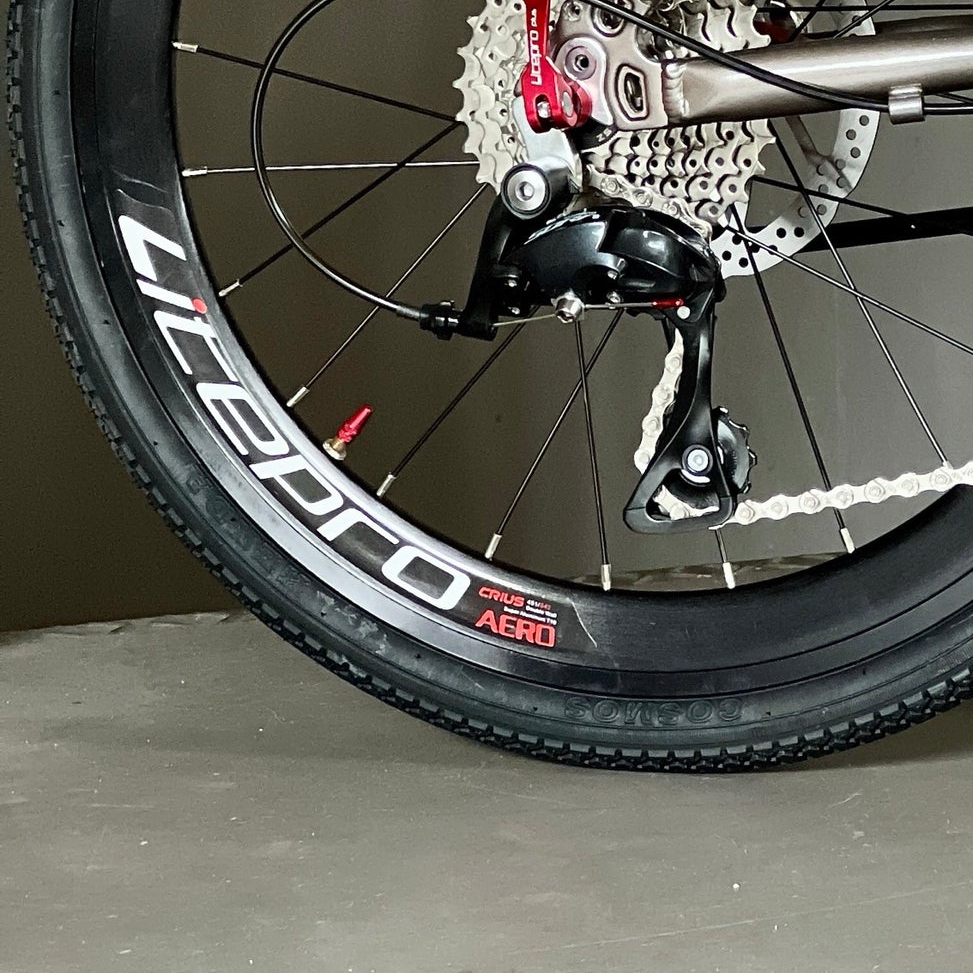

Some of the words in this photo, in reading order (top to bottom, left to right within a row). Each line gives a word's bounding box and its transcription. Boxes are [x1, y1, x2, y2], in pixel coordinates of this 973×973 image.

[118, 214, 471, 611] Litepro
[478, 586, 525, 608] CRIUS
[474, 609, 556, 648] AERO
[563, 695, 744, 726] COSMOS
